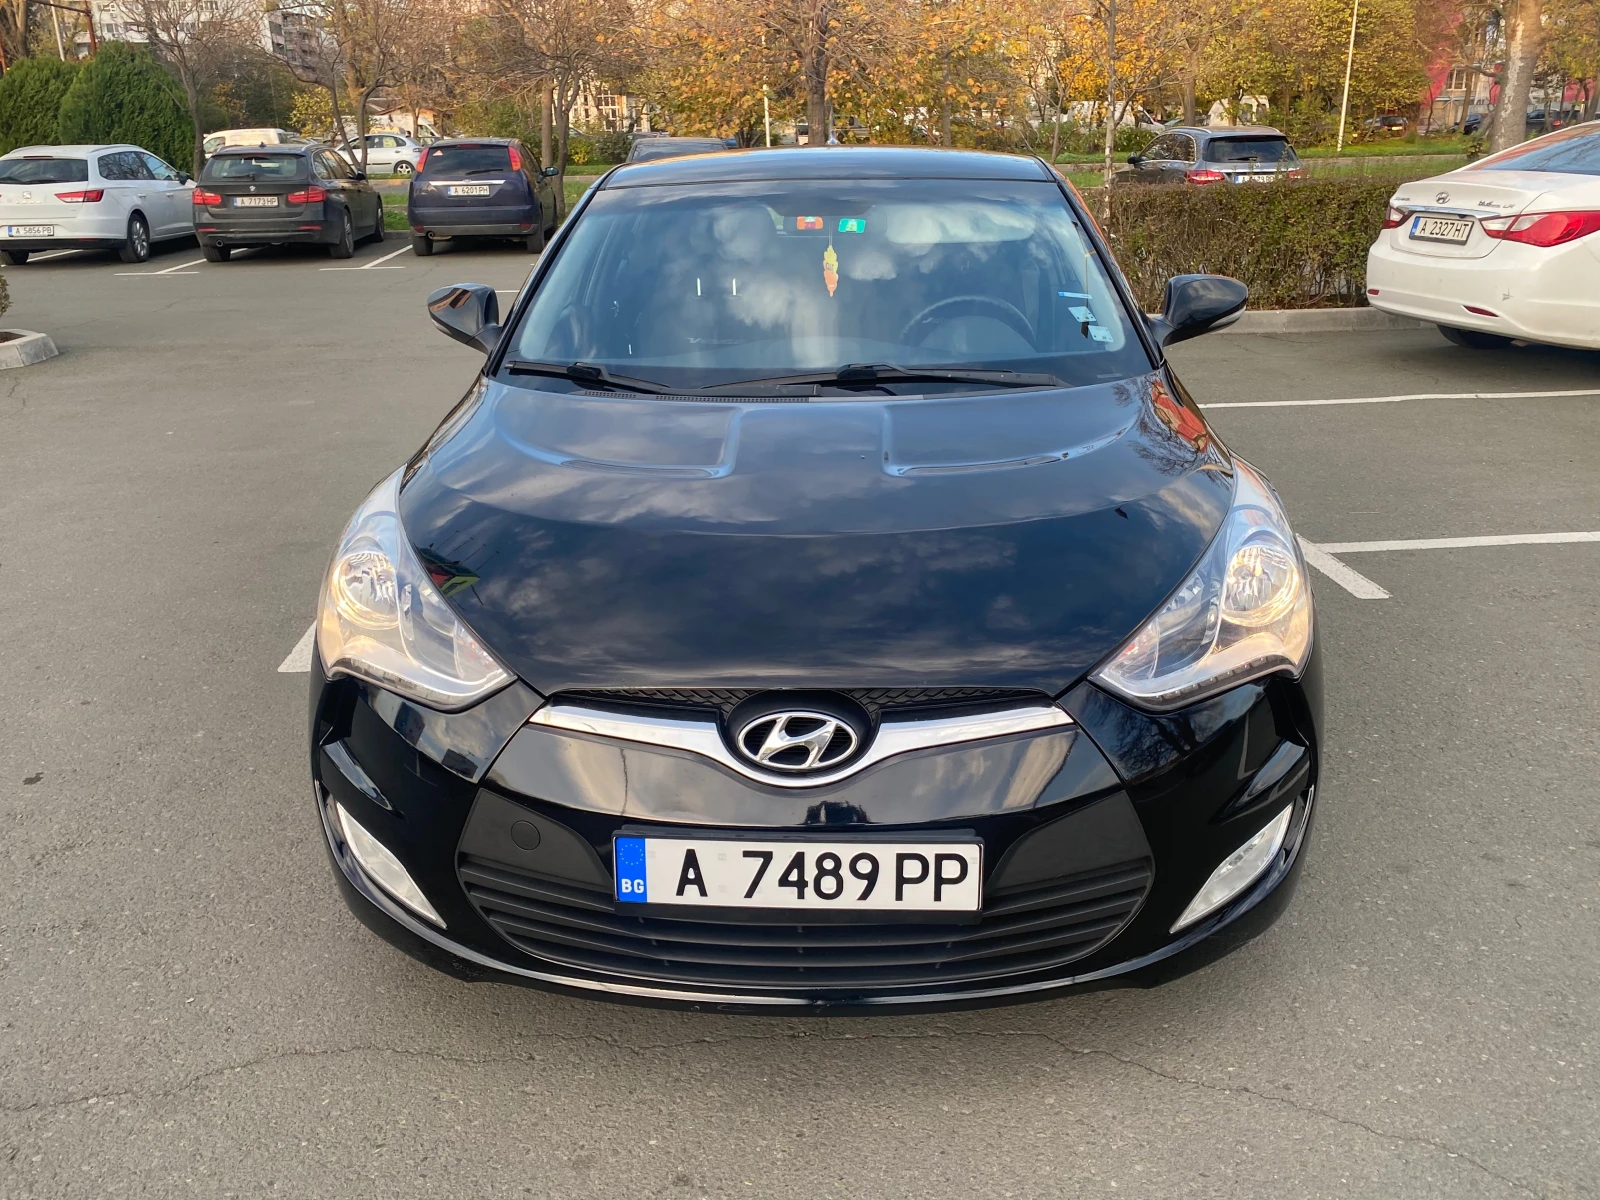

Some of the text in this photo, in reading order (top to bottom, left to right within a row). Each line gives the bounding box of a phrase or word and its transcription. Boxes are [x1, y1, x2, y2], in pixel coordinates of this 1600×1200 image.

[1420, 220, 1428, 234] A
[675, 848, 969, 902] A 7489 PP
[621, 878, 645, 893] BG
